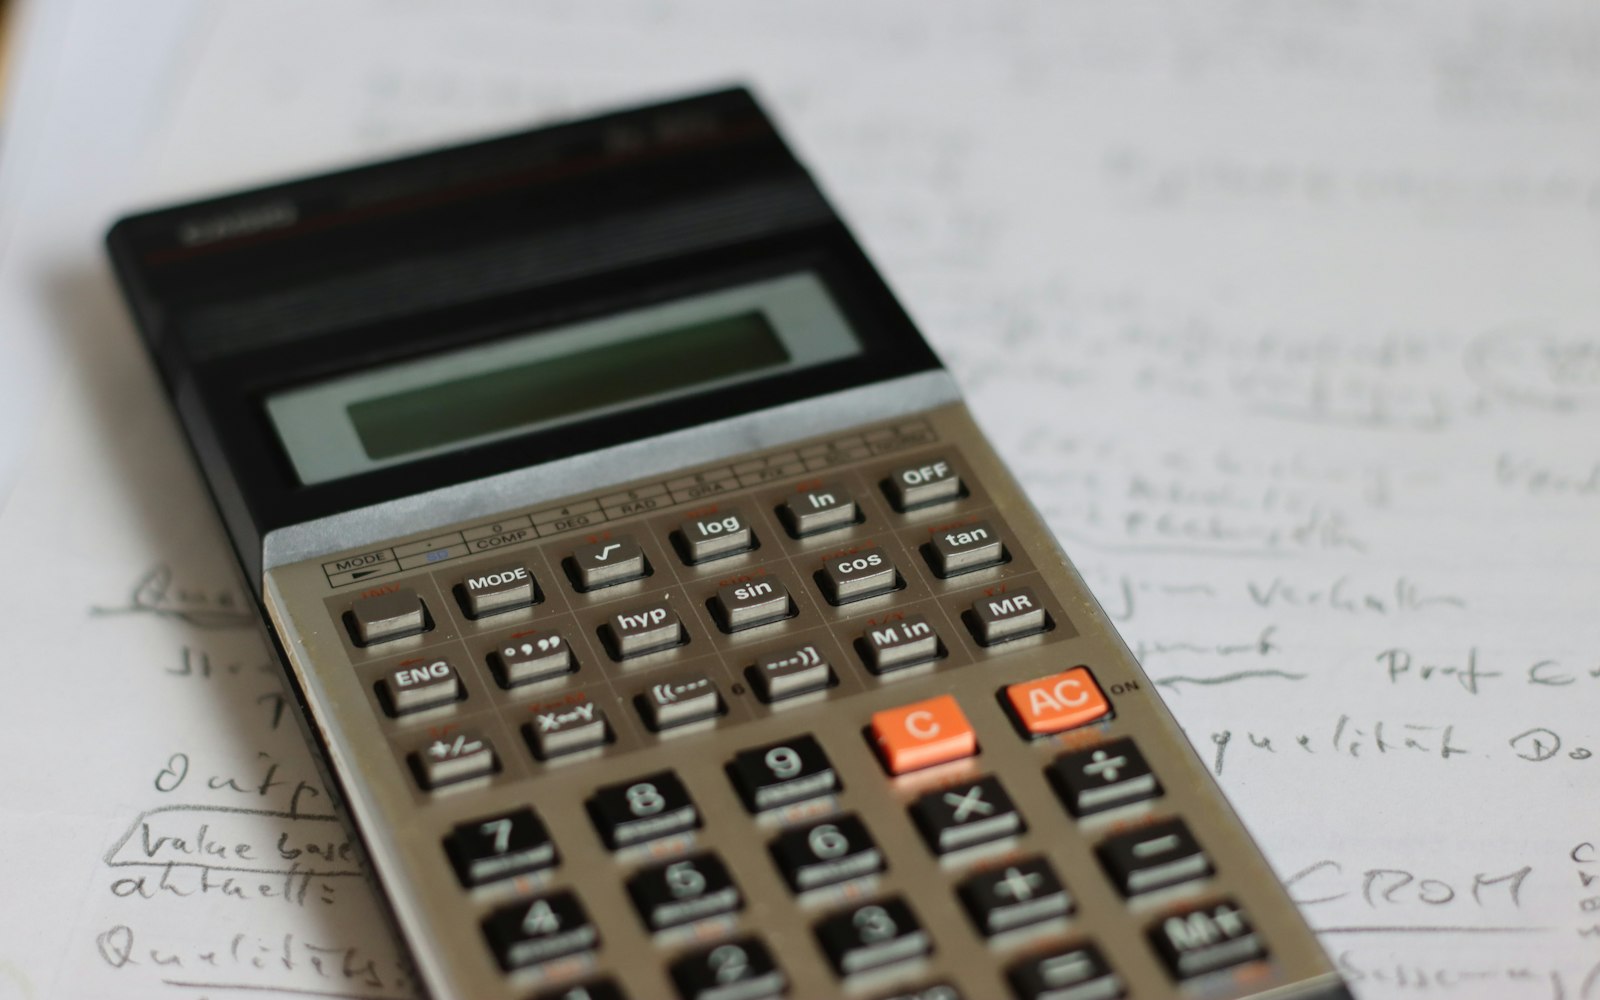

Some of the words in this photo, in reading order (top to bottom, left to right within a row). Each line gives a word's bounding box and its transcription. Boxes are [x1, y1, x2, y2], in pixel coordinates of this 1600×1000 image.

[902, 461, 948, 485] OFF
[621, 499, 657, 515] RAD
[808, 492, 836, 508] ln
[554, 515, 591, 532] DEG
[697, 514, 741, 537] log
[475, 529, 529, 551] COMP
[944, 525, 988, 547] tan
[335, 551, 387, 572] MODE
[837, 552, 882, 575] cos
[467, 566, 528, 591] MODE
[734, 580, 773, 600] sin
[988, 594, 1032, 617] MR
[618, 606, 668, 630] hyp
[395, 660, 450, 688] ENG
[1028, 678, 1090, 716] AC
[1111, 680, 1140, 696] ON
[904, 709, 941, 740] C
[764, 746, 804, 780] 9
[625, 782, 666, 816] 8
[480, 818, 513, 852] 7
[807, 824, 851, 860] 6
[664, 860, 706, 899] 5
[522, 898, 561, 936] 4
[851, 904, 898, 945] 3
[707, 943, 749, 984] 2
